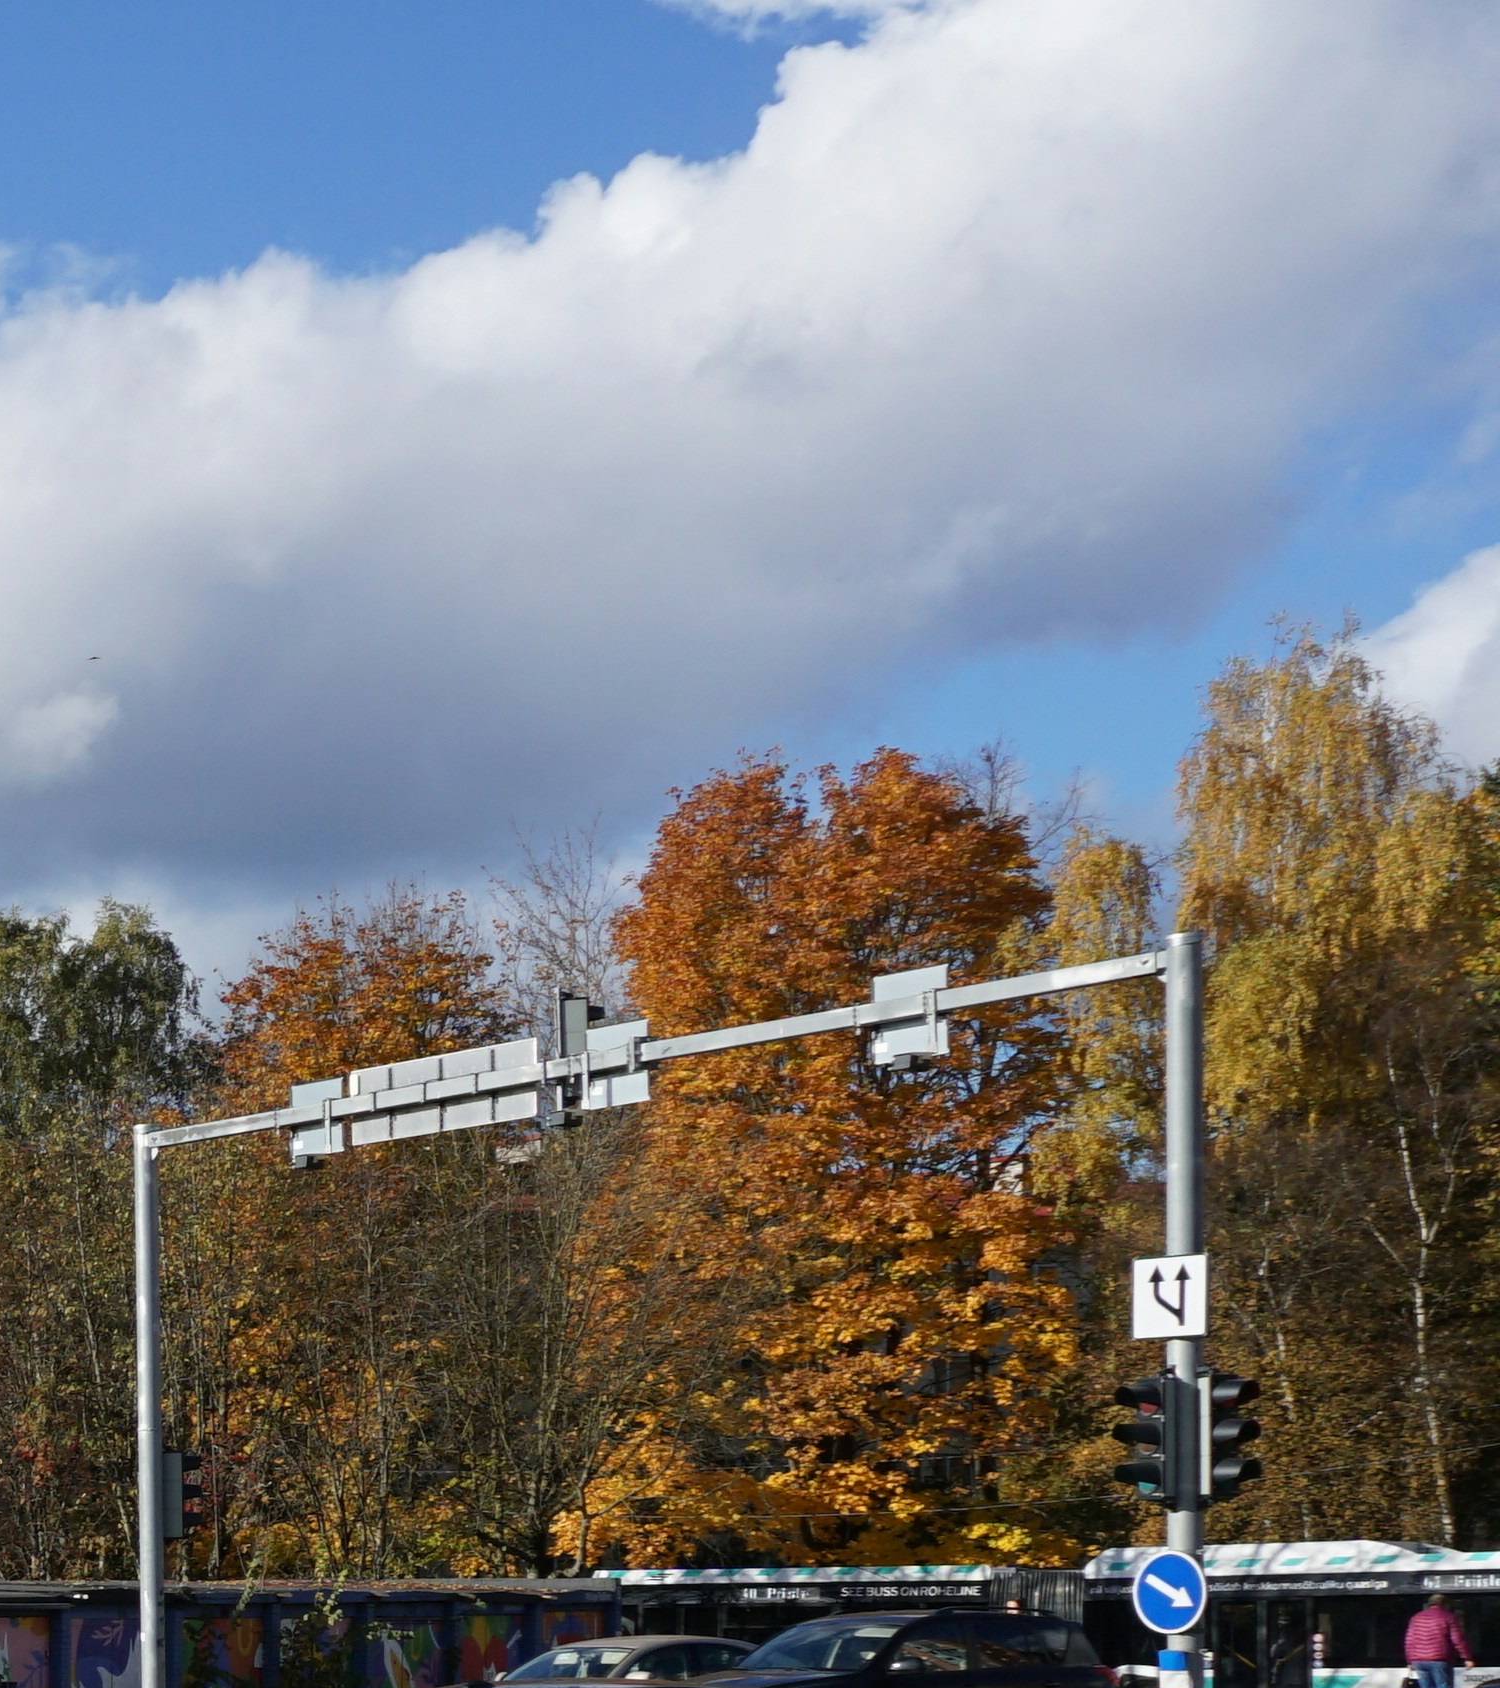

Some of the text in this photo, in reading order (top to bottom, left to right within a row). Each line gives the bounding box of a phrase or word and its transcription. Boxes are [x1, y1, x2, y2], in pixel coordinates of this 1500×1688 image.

[840, 1585, 982, 1597] SEE BUSS ON ROHELINE
